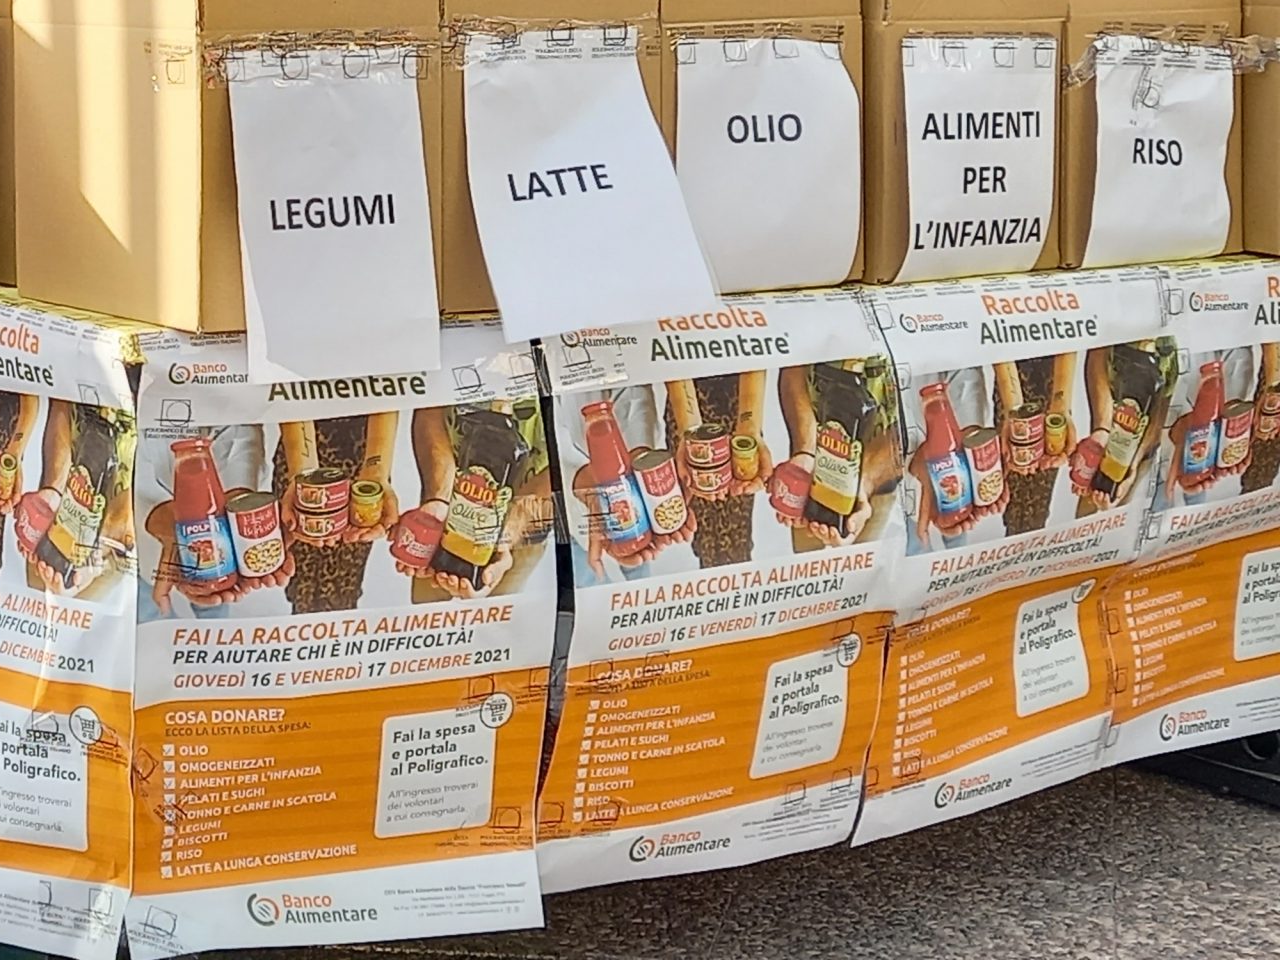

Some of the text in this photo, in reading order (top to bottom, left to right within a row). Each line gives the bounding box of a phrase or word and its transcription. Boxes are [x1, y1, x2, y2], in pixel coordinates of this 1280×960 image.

[727, 114, 803, 143] OLIO
[922, 111, 1041, 141] ALIMENTI
[1132, 138, 1183, 166] RISO
[507, 163, 613, 203] LATTE
[963, 165, 1006, 194] PER
[270, 194, 396, 231] LEGUMI
[914, 217, 1042, 250] L'INFANZIA
[980, 289, 1080, 316] Raccolta
[980, 315, 1098, 345] Alimentare
[650, 333, 789, 362] Alimentare
[192, 362, 227, 374] Banco
[191, 373, 248, 385] Alimentar
[268, 371, 426, 402] Alimentare
[820, 436, 849, 456] OLIO
[460, 481, 493, 503] OLIO
[930, 512, 1128, 577] FAI RACCOLTA ALIMENTARE
[611, 552, 873, 611] FAI LA RACCOLTA ALIMENTARE
[1, 595, 93, 629] ALIMENTARE
[610, 575, 844, 629] PER AIUTARE CHI È IN DIFFICOLTÀ!
[173, 605, 514, 646] FAI LA RACCOLTA ALIMENTARE
[608, 593, 868, 651] GIOVEDÌ 16 E VENERDÌ 17 DICEMBRE 2021
[172, 627, 474, 664] PER AIUTARE CHI È IN DIFFICOLTÀ!
[0, 640, 56, 667] DICEMBRE
[58, 656, 94, 673] 2021
[174, 648, 511, 688] GIOVEDÌ 16 E VENERDÌ 17 DICEMBRE 2021
[774, 664, 833, 688] Fai la spesa
[602, 699, 628, 709] OLIO
[782, 682, 820, 705] portala
[165, 708, 285, 725] COSA DONARE?
[600, 705, 680, 722] OMOGENEIZZATI
[768, 707, 779, 720] al
[1178, 708, 1207, 723] Banco
[12, 721, 21, 736] la
[165, 722, 312, 737] ECCO LA LISTA DELLA SPESA:
[393, 724, 476, 743] Fai la spesa
[596, 722, 645, 736] ALIMENTI
[646, 720, 665, 730] PER
[1177, 716, 1230, 737] Alimentare
[1, 741, 48, 758] portala
[179, 745, 208, 756] OLIO
[392, 741, 457, 761] e portala
[592, 737, 725, 764] TONNO CARNE SCATOLA
[594, 734, 669, 749] PELATI SUGHI
[3, 757, 81, 782] Poligrafico.
[179, 757, 275, 773] OMOGENEIZZATI
[390, 754, 488, 776] al Poligrafico.
[590, 766, 629, 778] LEGUMI
[180, 765, 322, 789] ALIMENTI PER L'INFANZIA
[588, 780, 634, 792] BISCOTTI
[959, 773, 990, 789] Banco
[180, 788, 265, 805] PELATI SUGHI
[233, 800, 270, 813] CARNE
[272, 798, 285, 807] IN
[286, 792, 337, 806] SCATOLA
[179, 820, 221, 835] LEGUMI
[660, 830, 701, 845] Banco
[177, 832, 228, 847] BISCOTTI
[654, 836, 731, 859] Alimentare
[176, 849, 202, 860] RISO
[176, 844, 357, 877] LATTE A LUNGA CONSERVAZIONE
[282, 893, 332, 908] Banco
[284, 906, 378, 924] Alimentare
